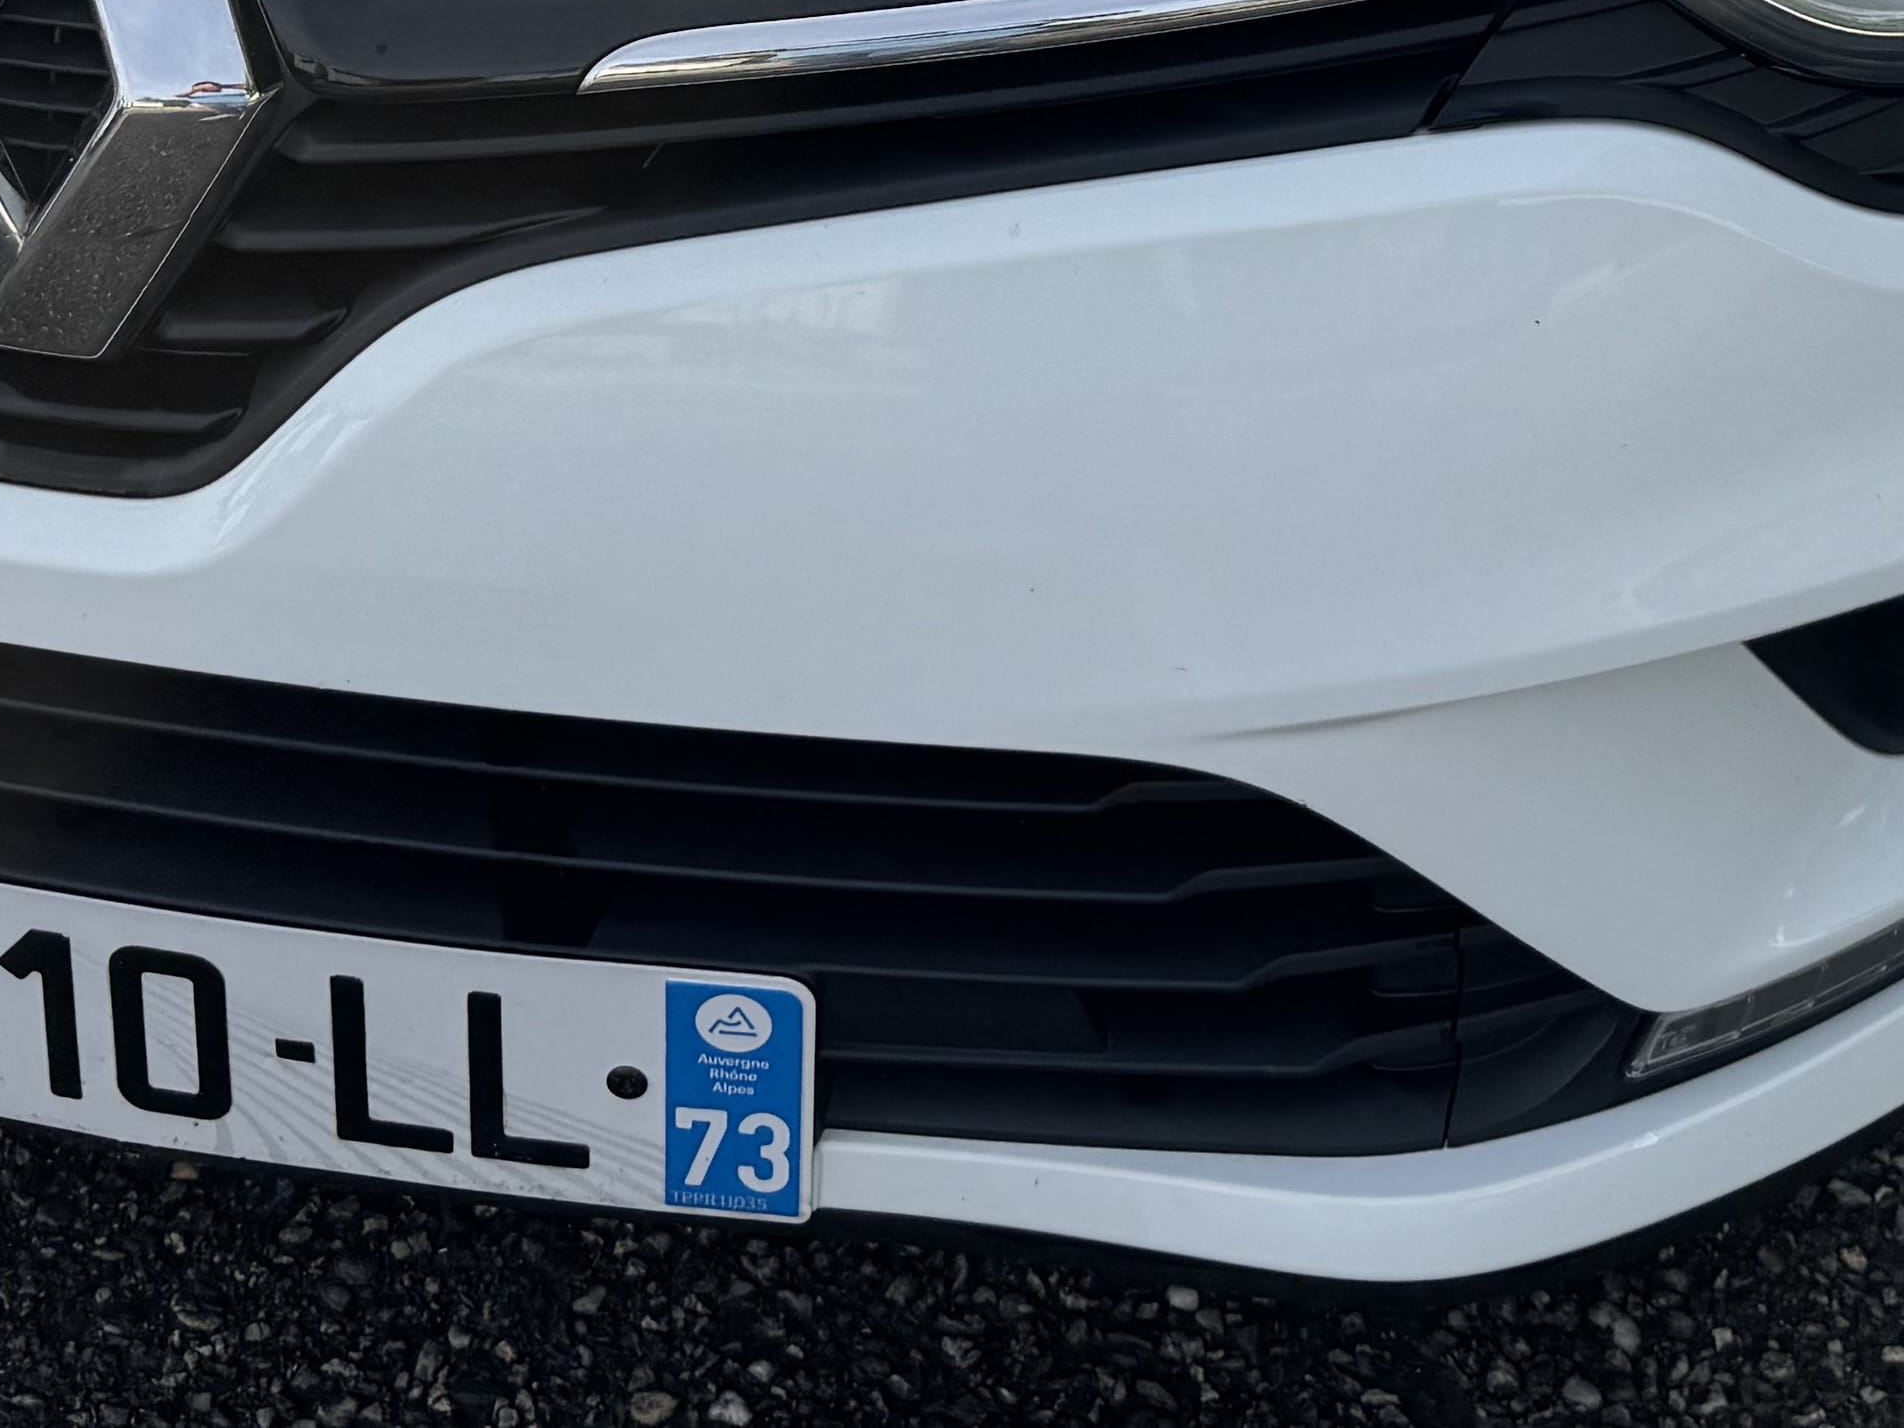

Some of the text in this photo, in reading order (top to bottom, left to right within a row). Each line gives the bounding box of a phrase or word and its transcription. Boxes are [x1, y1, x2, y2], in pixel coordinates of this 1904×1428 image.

[698, 1053, 770, 1071] Auvergne
[709, 1068, 758, 1083] Rhône
[712, 1081, 755, 1096] Alpes
[675, 1106, 791, 1194] 73
